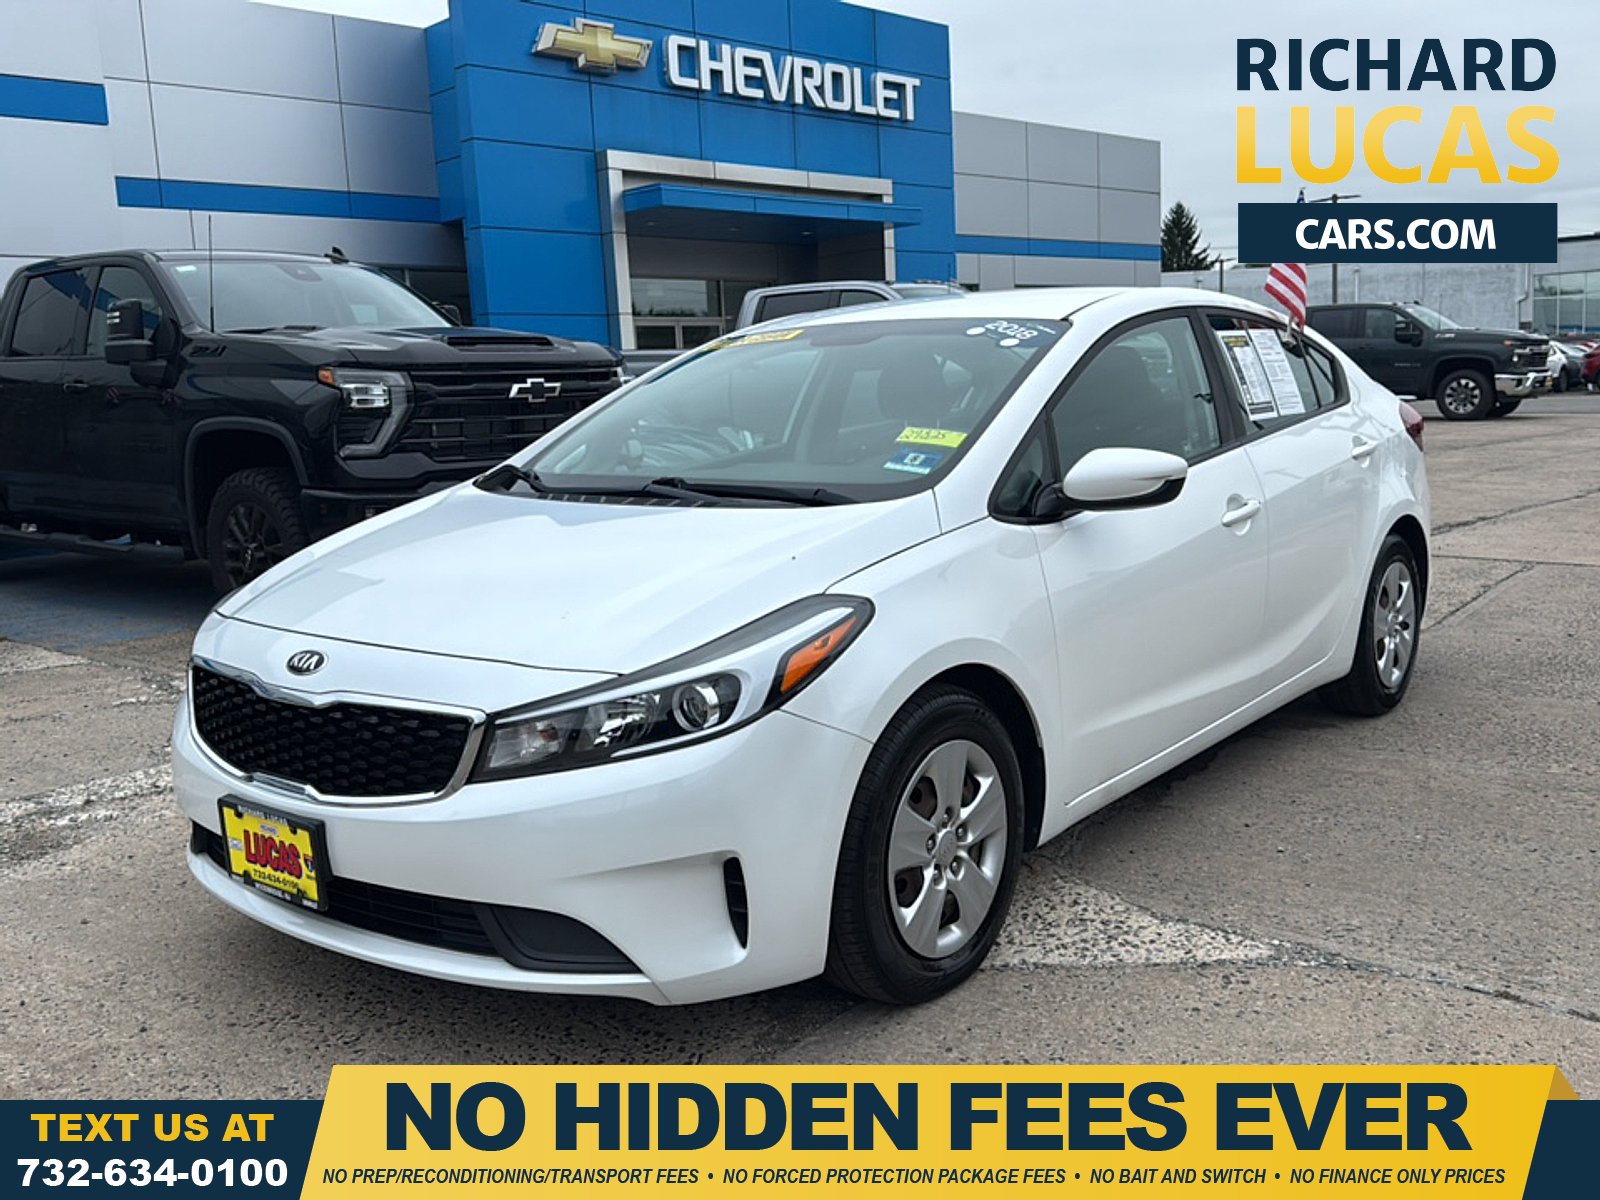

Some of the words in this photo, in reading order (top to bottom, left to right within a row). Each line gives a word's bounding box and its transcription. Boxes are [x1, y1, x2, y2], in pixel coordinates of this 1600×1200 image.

[664, 34, 921, 121] CHEVROLET
[290, 653, 319, 670] KIA
[243, 828, 303, 880] LUCAS
